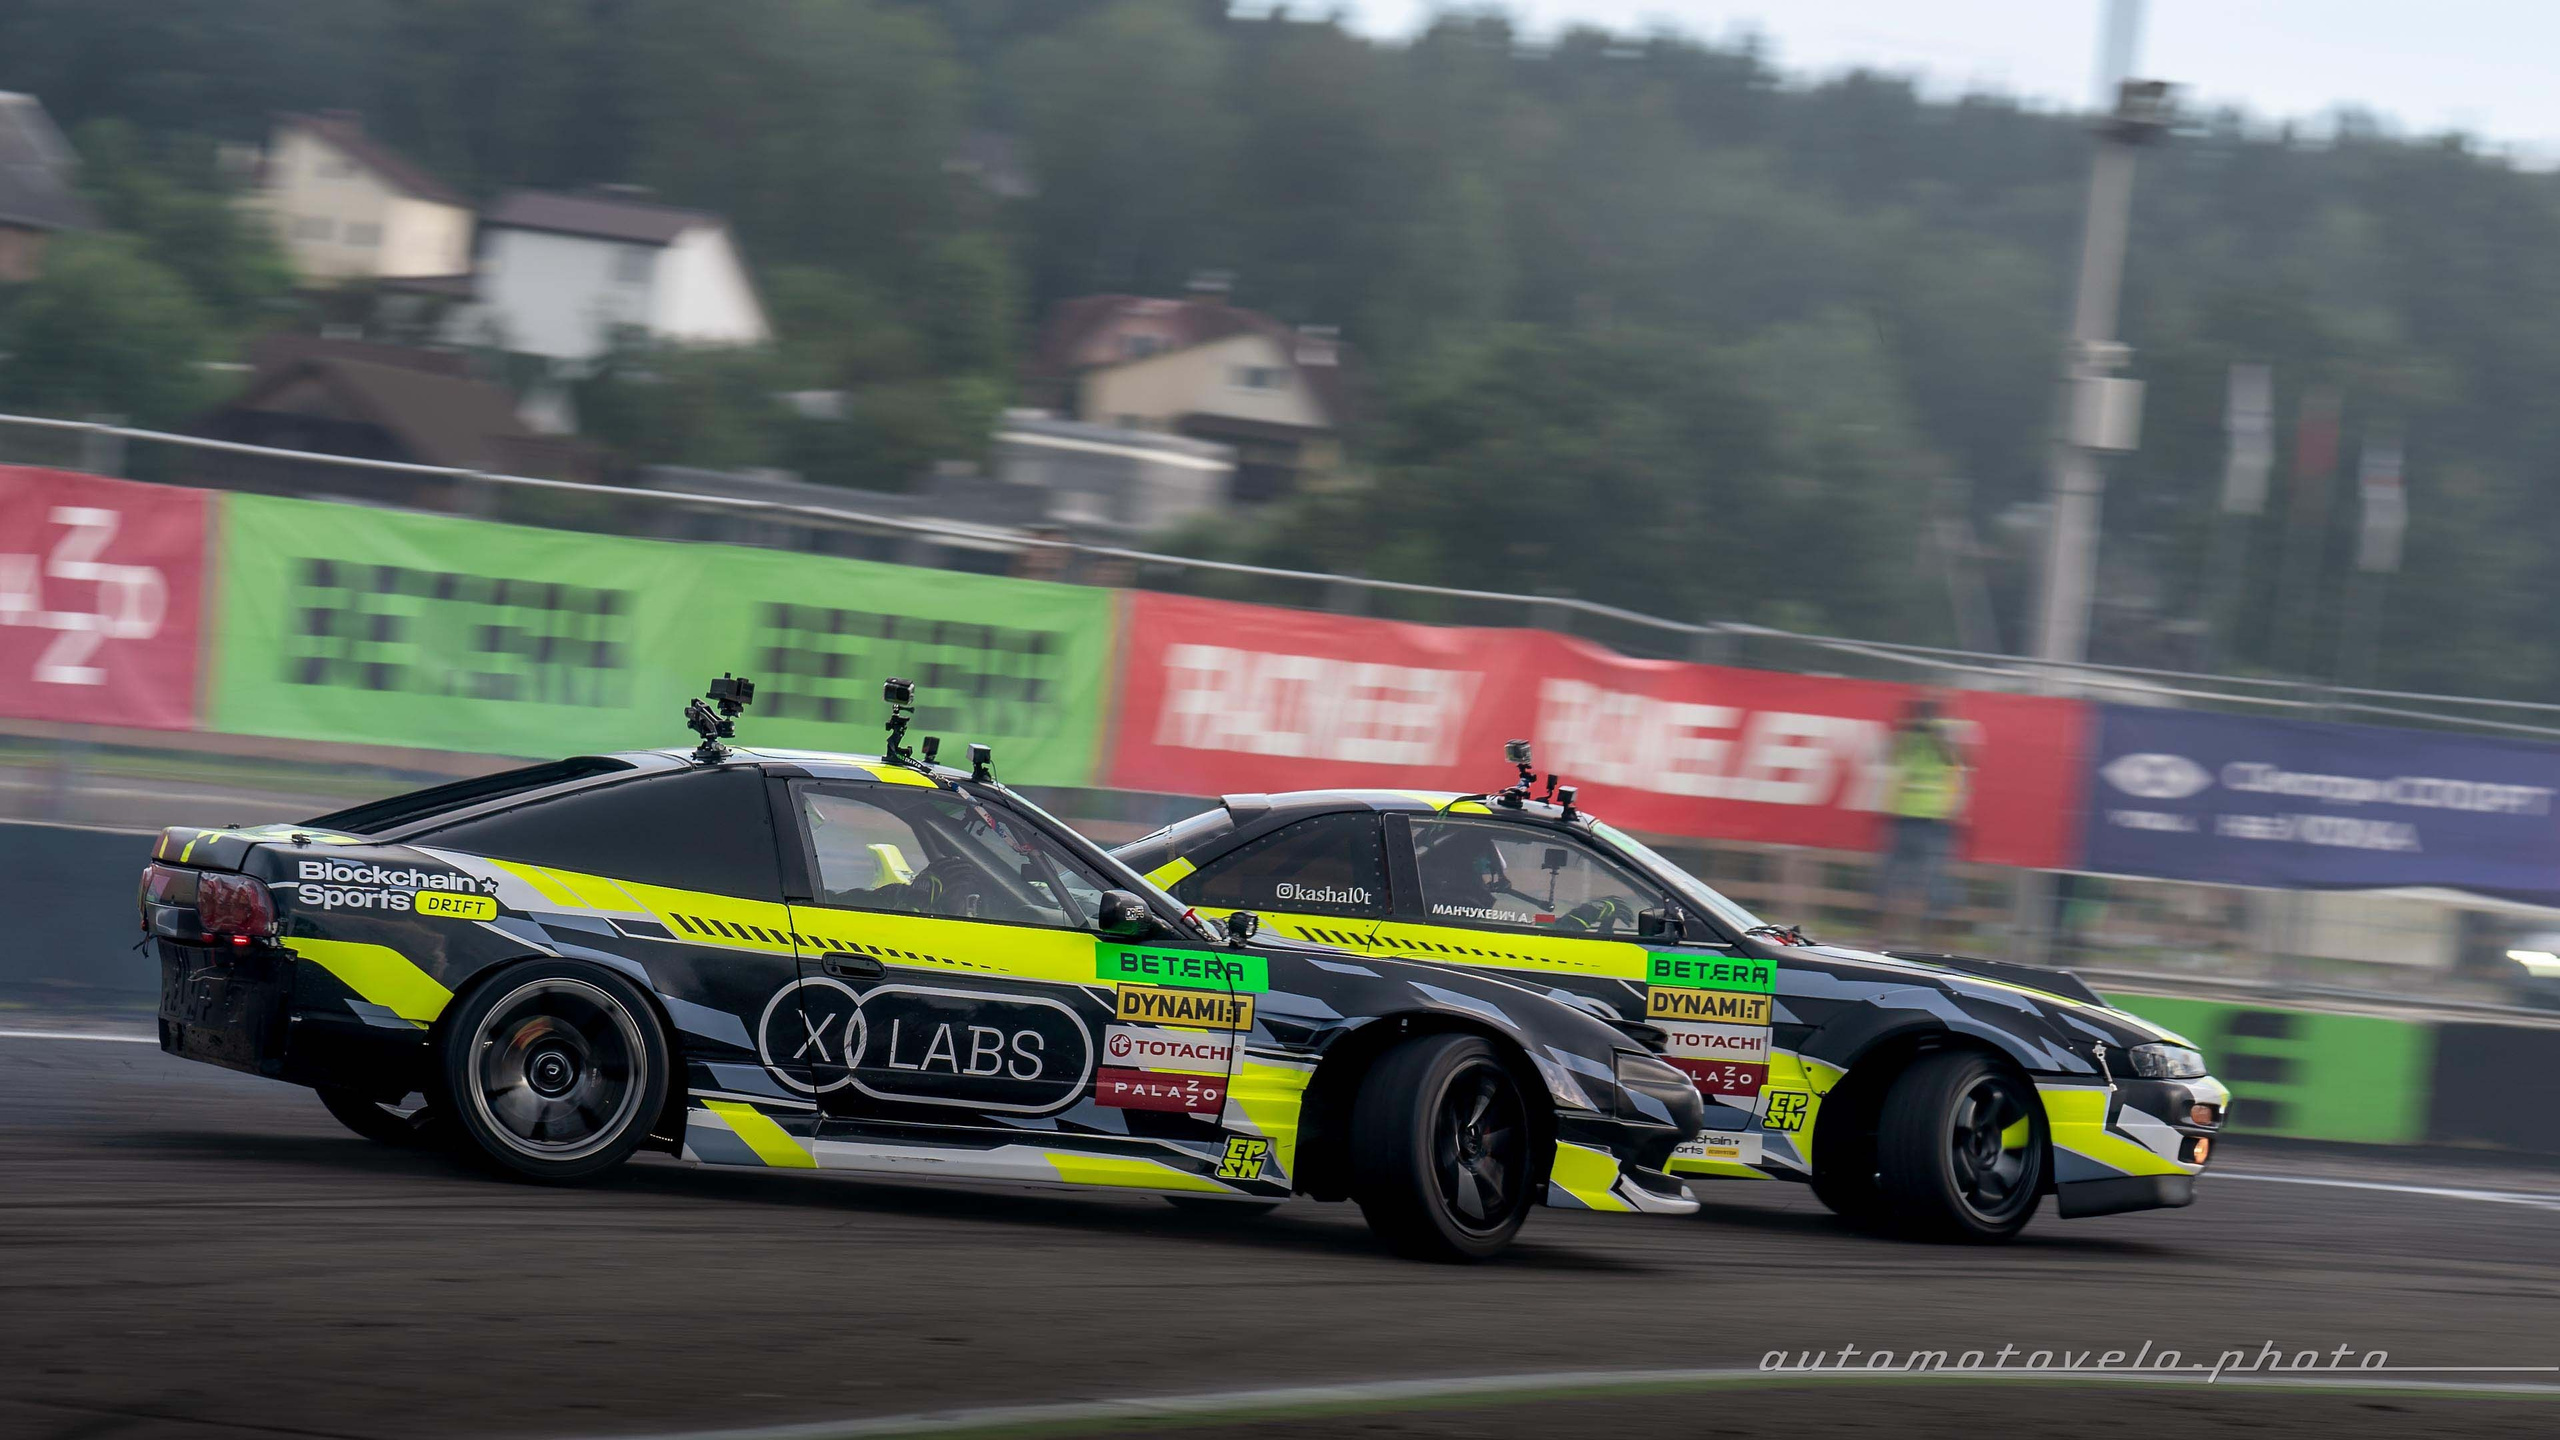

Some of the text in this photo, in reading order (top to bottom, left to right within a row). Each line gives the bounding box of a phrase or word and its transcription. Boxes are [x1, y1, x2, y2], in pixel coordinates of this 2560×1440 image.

[299, 861, 476, 893] Blockchain
[299, 884, 486, 915] Sports DRIFT
[1432, 904, 1516, 922] МАНЧУКЕВИЧ
[793, 1010, 1045, 1081] X LABS
[1135, 1040, 1232, 1061] TOTACHI
[1672, 1033, 1762, 1051] TOTACHI
[1114, 1080, 1217, 1107] PALAZZO
